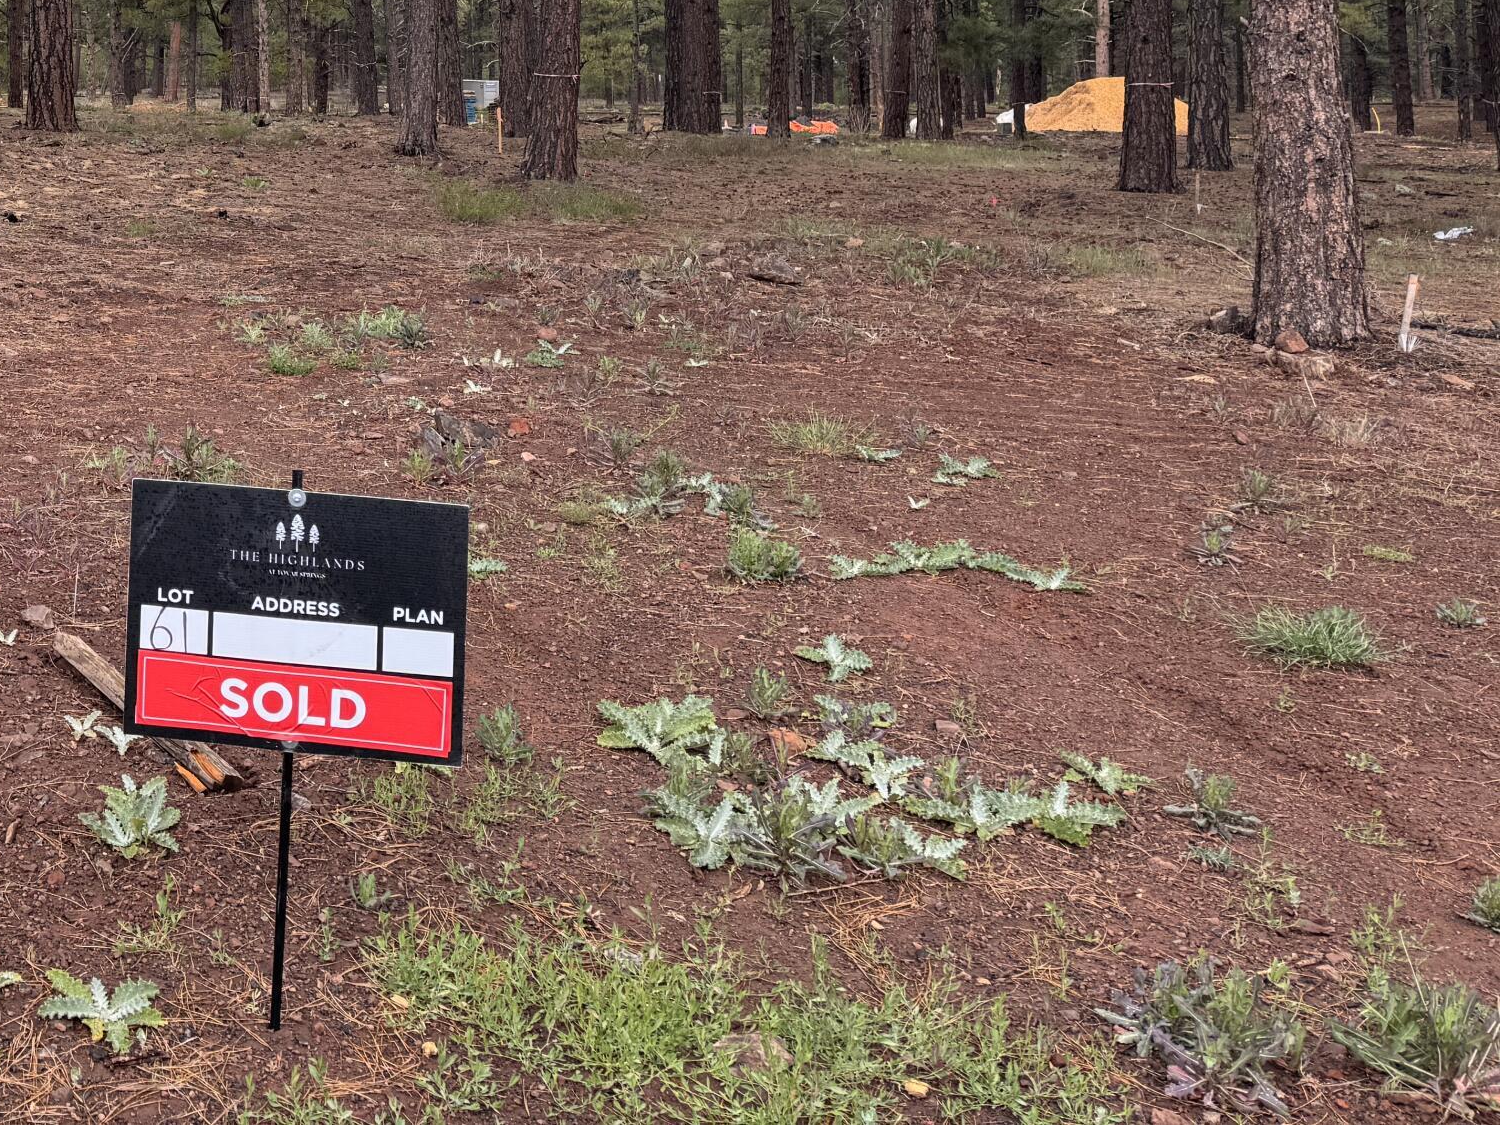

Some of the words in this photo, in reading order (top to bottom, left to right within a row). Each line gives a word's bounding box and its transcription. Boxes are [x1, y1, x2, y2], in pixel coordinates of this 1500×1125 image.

[230, 549, 260, 562] THE
[269, 553, 365, 571] HIGHLANDS
[157, 587, 195, 604] LOT
[251, 596, 340, 617] ADDRESS
[393, 607, 444, 625] PLAN
[150, 606, 187, 653] 61
[220, 677, 366, 729] SOLD
